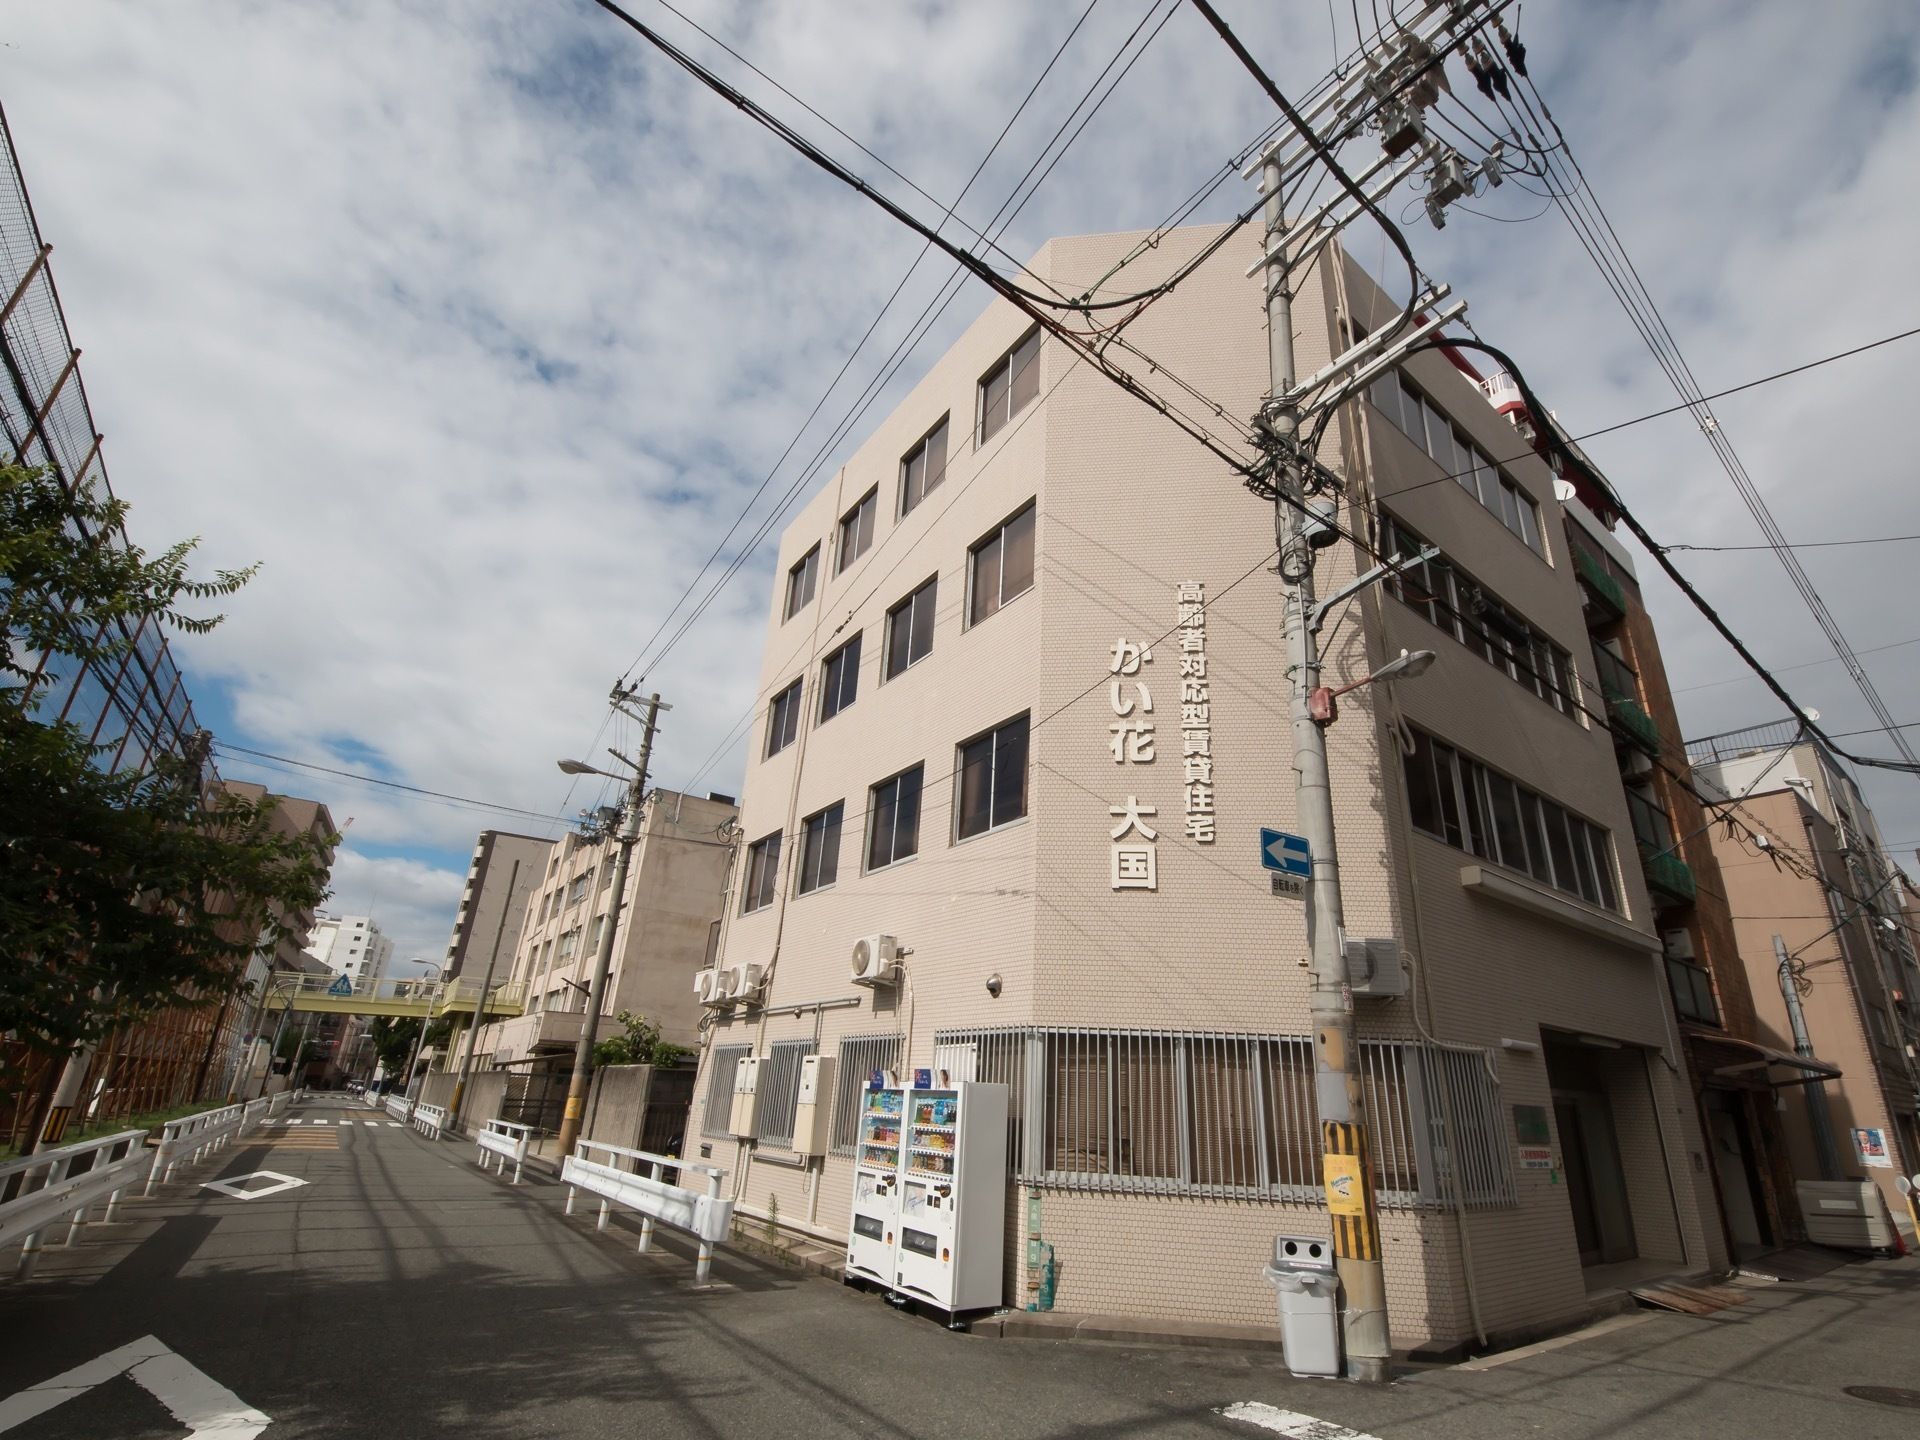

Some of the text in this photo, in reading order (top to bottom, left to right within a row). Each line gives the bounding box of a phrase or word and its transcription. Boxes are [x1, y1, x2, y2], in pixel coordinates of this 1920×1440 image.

[1109, 637, 1157, 889] かい花 大国
[1177, 580, 1215, 842] 高齢者対応型賃貸住宅
